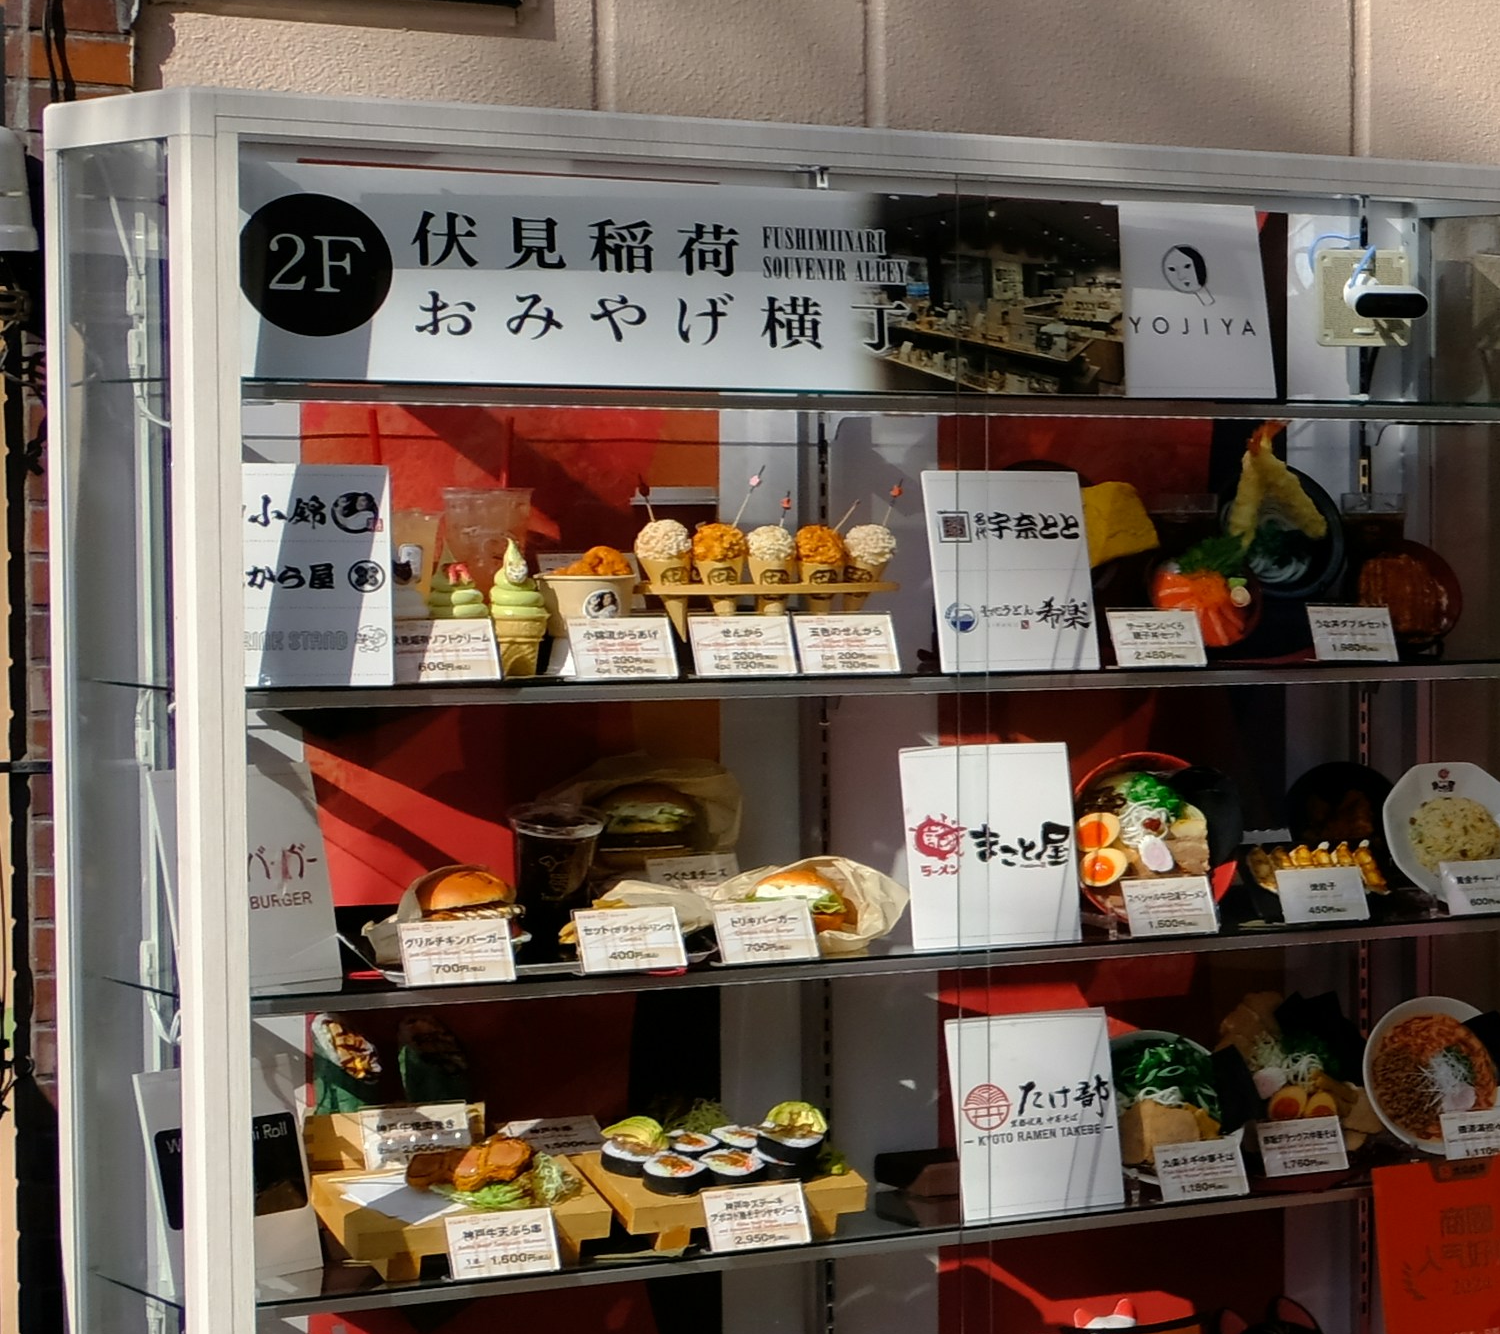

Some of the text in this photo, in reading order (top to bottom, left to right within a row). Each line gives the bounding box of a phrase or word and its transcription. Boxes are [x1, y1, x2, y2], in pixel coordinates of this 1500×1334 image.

[411, 210, 740, 277] 伏見稲荷
[762, 225, 887, 255] FUSHIMIINARI
[268, 233, 367, 293] 2F
[763, 255, 908, 284] SOUVENIR ALLEY
[414, 290, 911, 353] おみやげ横丁
[1128, 316, 1257, 338] YOJIYA
[243, 494, 327, 530] 小錦
[921, 864, 961, 877] ラーメン
[249, 891, 313, 911] BURGER
[404, 933, 508, 949] グリルチキンバーガー
[263, 1121, 288, 1139] Roll
[977, 1124, 1102, 1146] KYOTO RAMEN TAKEBE
